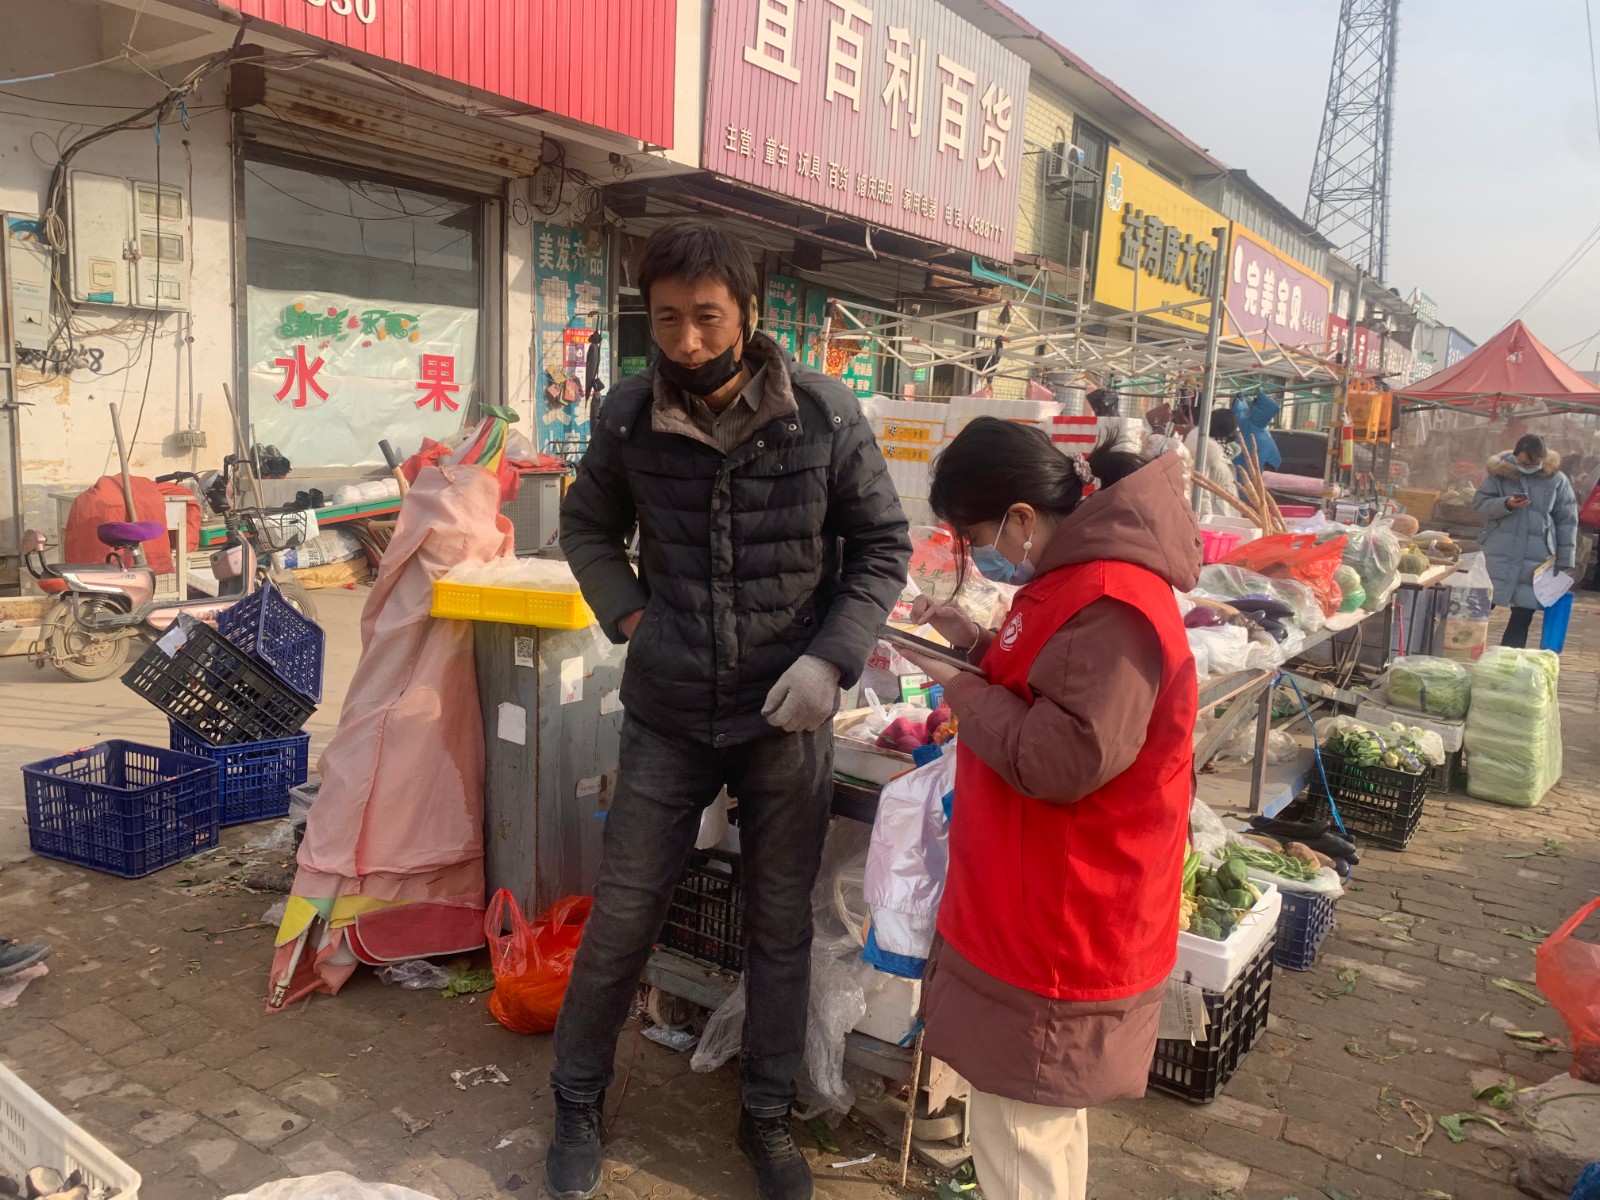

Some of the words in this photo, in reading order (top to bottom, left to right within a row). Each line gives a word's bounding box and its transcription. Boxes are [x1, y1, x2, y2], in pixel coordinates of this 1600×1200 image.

[763, 137, 789, 168] 童车
[797, 151, 821, 182] 玩具
[827, 160, 849, 191] 百货
[856, 173, 894, 205] 婚庆用品
[903, 187, 937, 220] 家用电器
[1243, 260, 1302, 332] 完美宝贝
